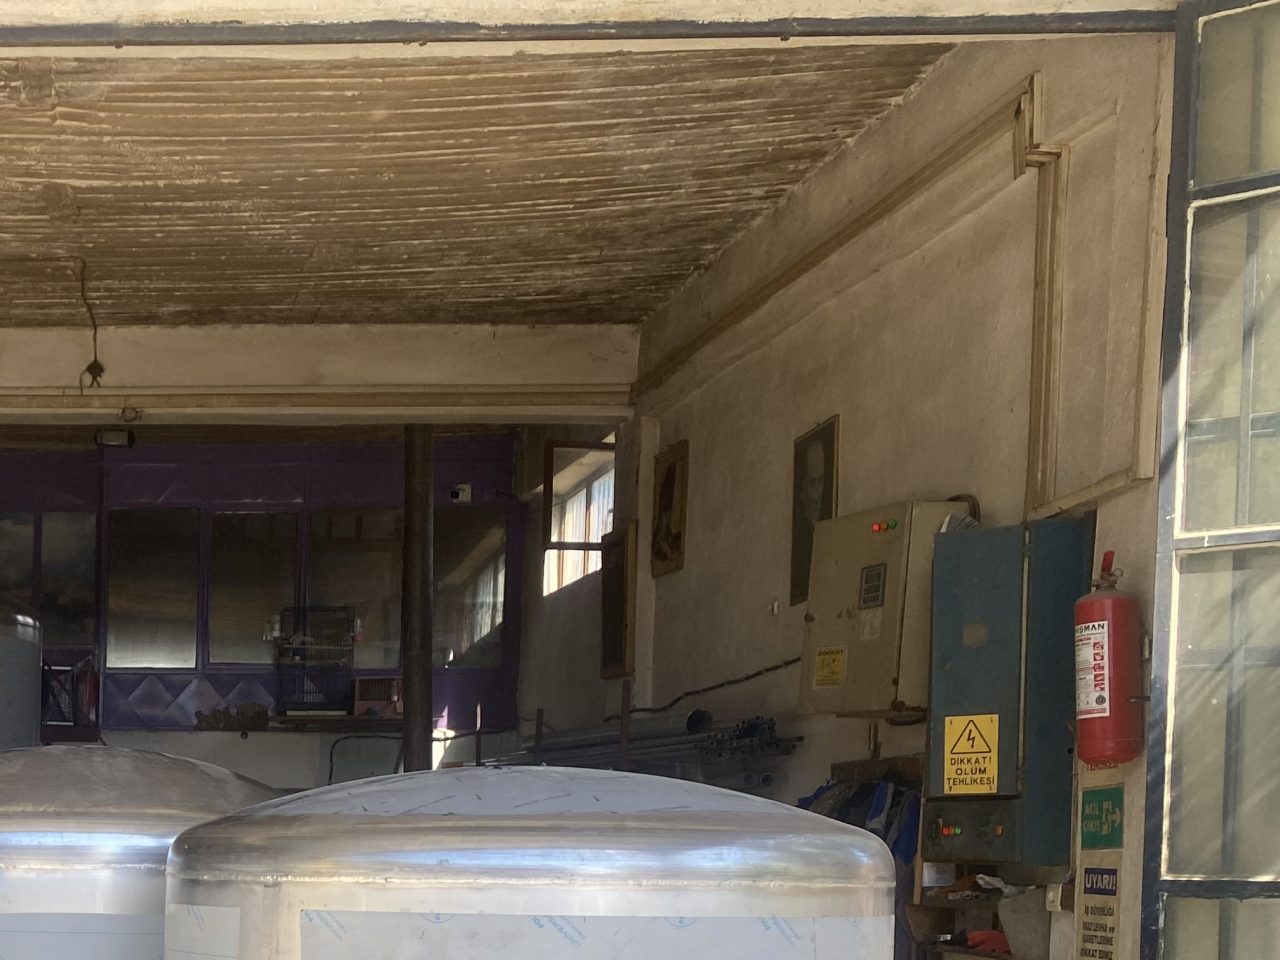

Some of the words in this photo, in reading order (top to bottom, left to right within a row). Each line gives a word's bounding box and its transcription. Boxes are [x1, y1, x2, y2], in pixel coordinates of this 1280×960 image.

[950, 756, 991, 766] DİKKAT!
[946, 775, 995, 786] TEHLİKESİ
[1085, 873, 1116, 889] UYARI!
